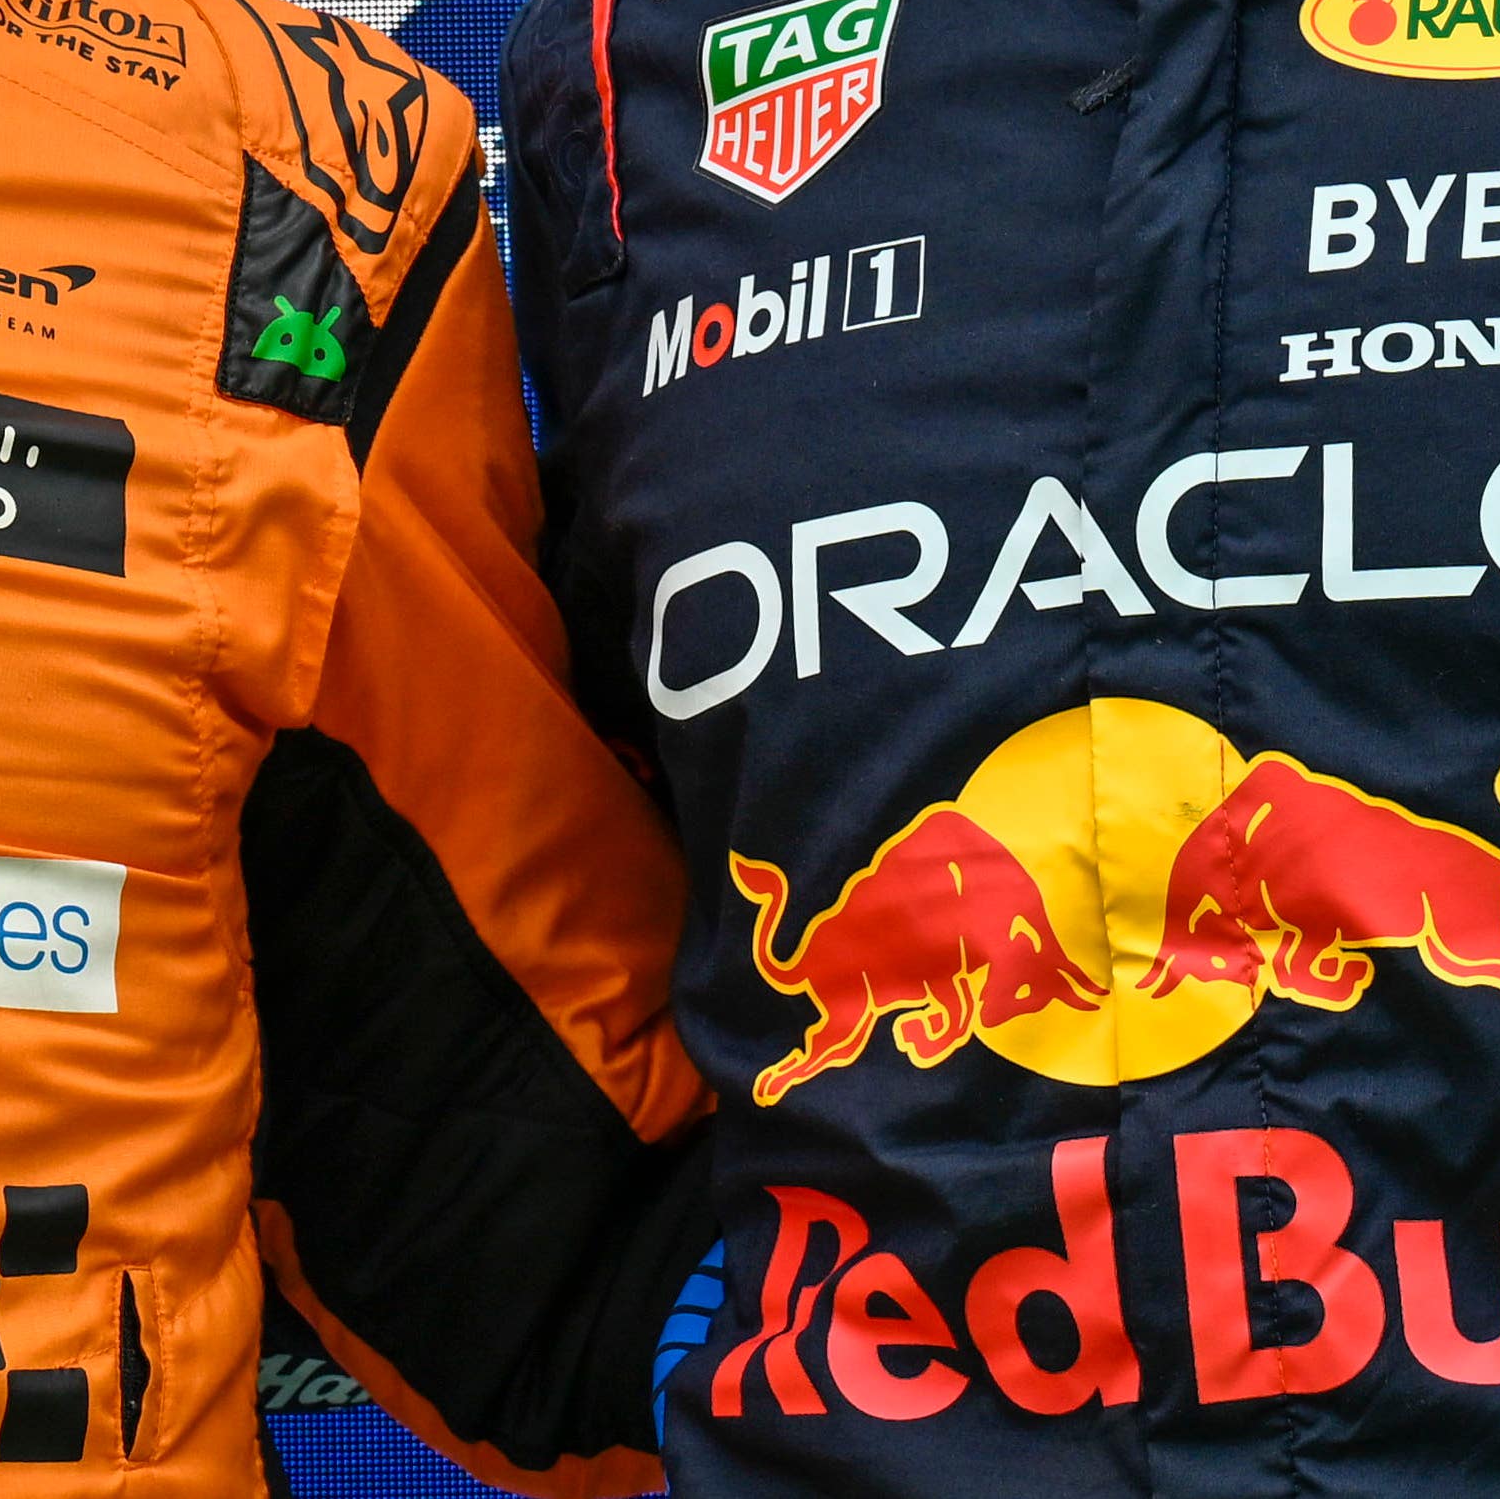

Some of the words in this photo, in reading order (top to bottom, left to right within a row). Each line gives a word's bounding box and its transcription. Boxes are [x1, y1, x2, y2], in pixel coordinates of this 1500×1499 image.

[35, 31, 96, 63] THE
[104, 55, 181, 93] STAY
[710, 59, 875, 194] HEUER
[641, 255, 831, 399] Mobil
[870, 248, 897, 319] 1
[709, 1134, 1142, 1422] Red
[257, 1353, 370, 1410] Ha
